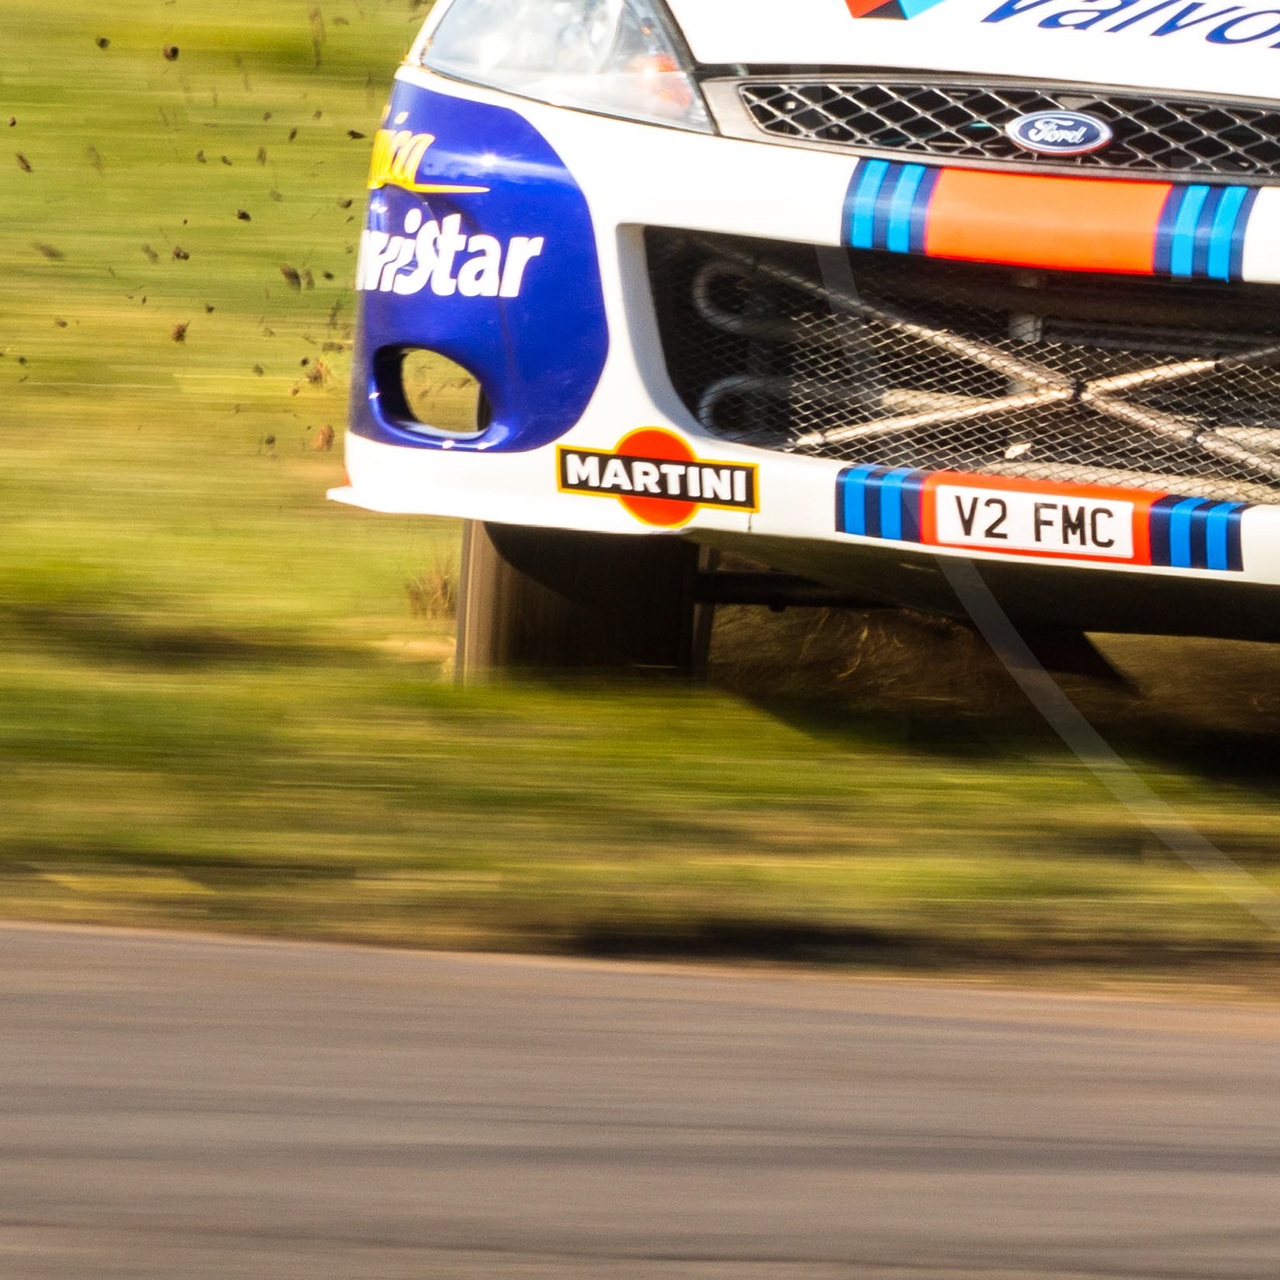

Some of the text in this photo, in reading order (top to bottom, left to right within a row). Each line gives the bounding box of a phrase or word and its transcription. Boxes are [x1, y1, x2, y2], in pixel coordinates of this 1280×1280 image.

[1026, 119, 1088, 147] Ford
[566, 453, 748, 502] MARTINI
[954, 495, 1116, 550] V2 FMC
